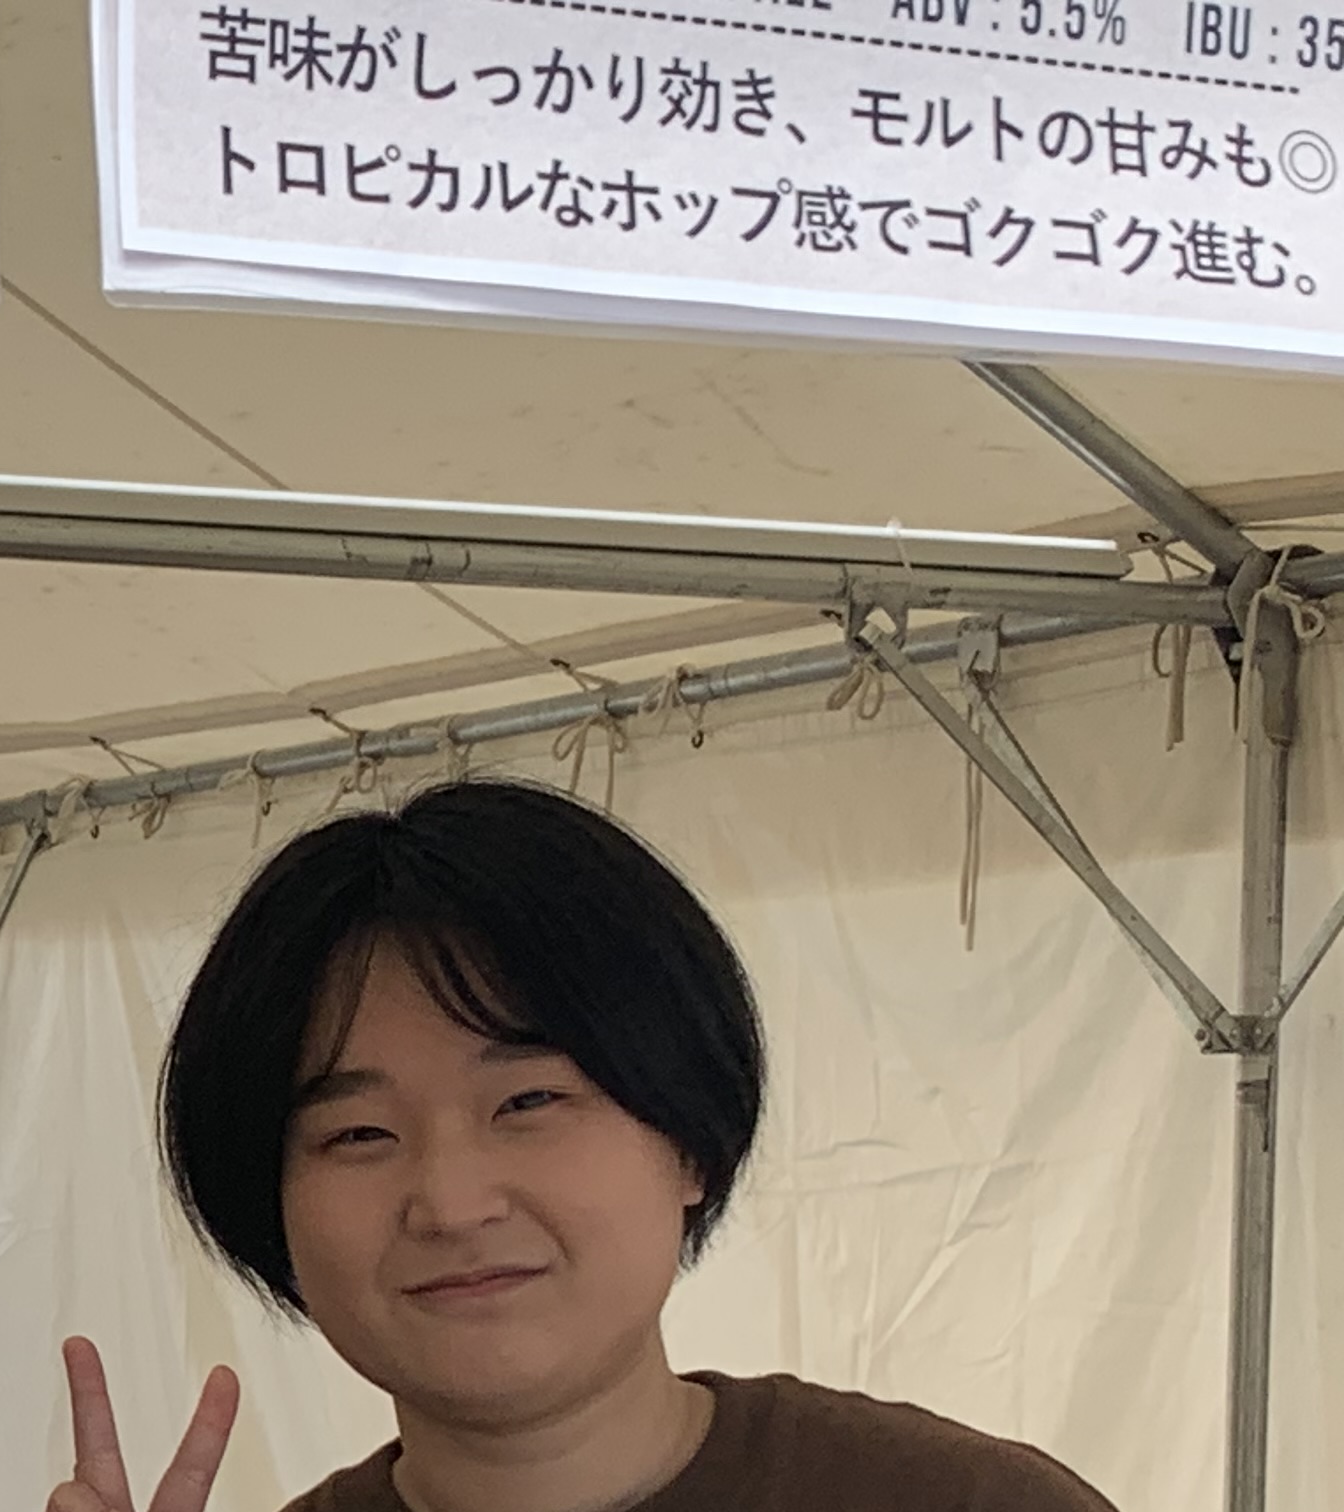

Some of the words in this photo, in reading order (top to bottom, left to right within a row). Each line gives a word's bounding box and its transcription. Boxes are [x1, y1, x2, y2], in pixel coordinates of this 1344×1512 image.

[1184, 0, 1254, 62] IBU
[219, 124, 1316, 297] トロピカルなホップ感でゴクゴク進む。
